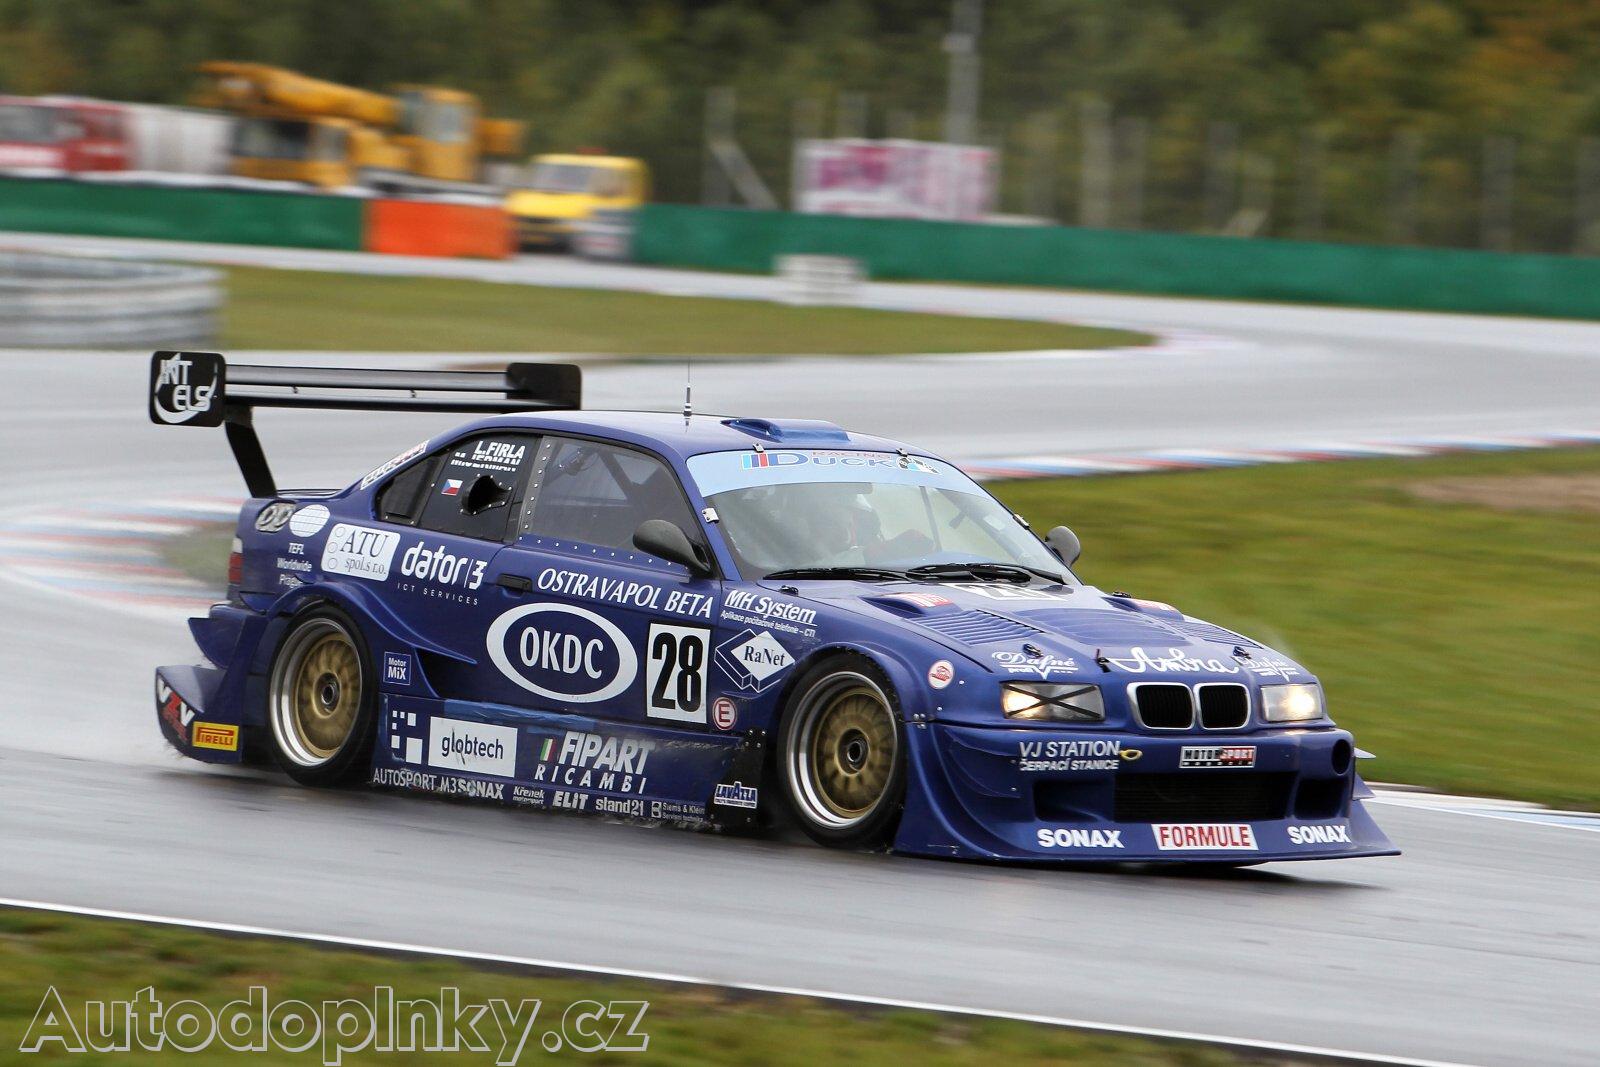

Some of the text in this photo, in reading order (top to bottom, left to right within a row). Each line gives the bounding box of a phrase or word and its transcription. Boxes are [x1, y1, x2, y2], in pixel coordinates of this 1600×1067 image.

[339, 530, 390, 558] ATU
[276, 557, 313, 572] Worldwide
[397, 582, 478, 606] ICT SERVICES
[537, 567, 714, 618] OSTRAVAPOL BETA
[724, 589, 816, 623] MH System
[388, 657, 407, 667] Motor
[519, 626, 604, 679] OKDC
[743, 645, 786, 667] RaNet
[651, 632, 704, 712] 28
[196, 726, 235, 747] PIRELLI
[441, 728, 504, 765] globtech
[558, 730, 656, 775] FIPART
[1019, 740, 1120, 758] VJ STATION
[1220, 748, 1254, 760] SPORT
[1019, 757, 1119, 771] ČERPACÍ STANICE
[373, 767, 437, 791] AUTOSPORT
[534, 763, 648, 795] RICAMBI
[1037, 828, 1125, 849] SONAX
[1159, 826, 1250, 848] FORMULE
[1286, 825, 1352, 845] SONAX
